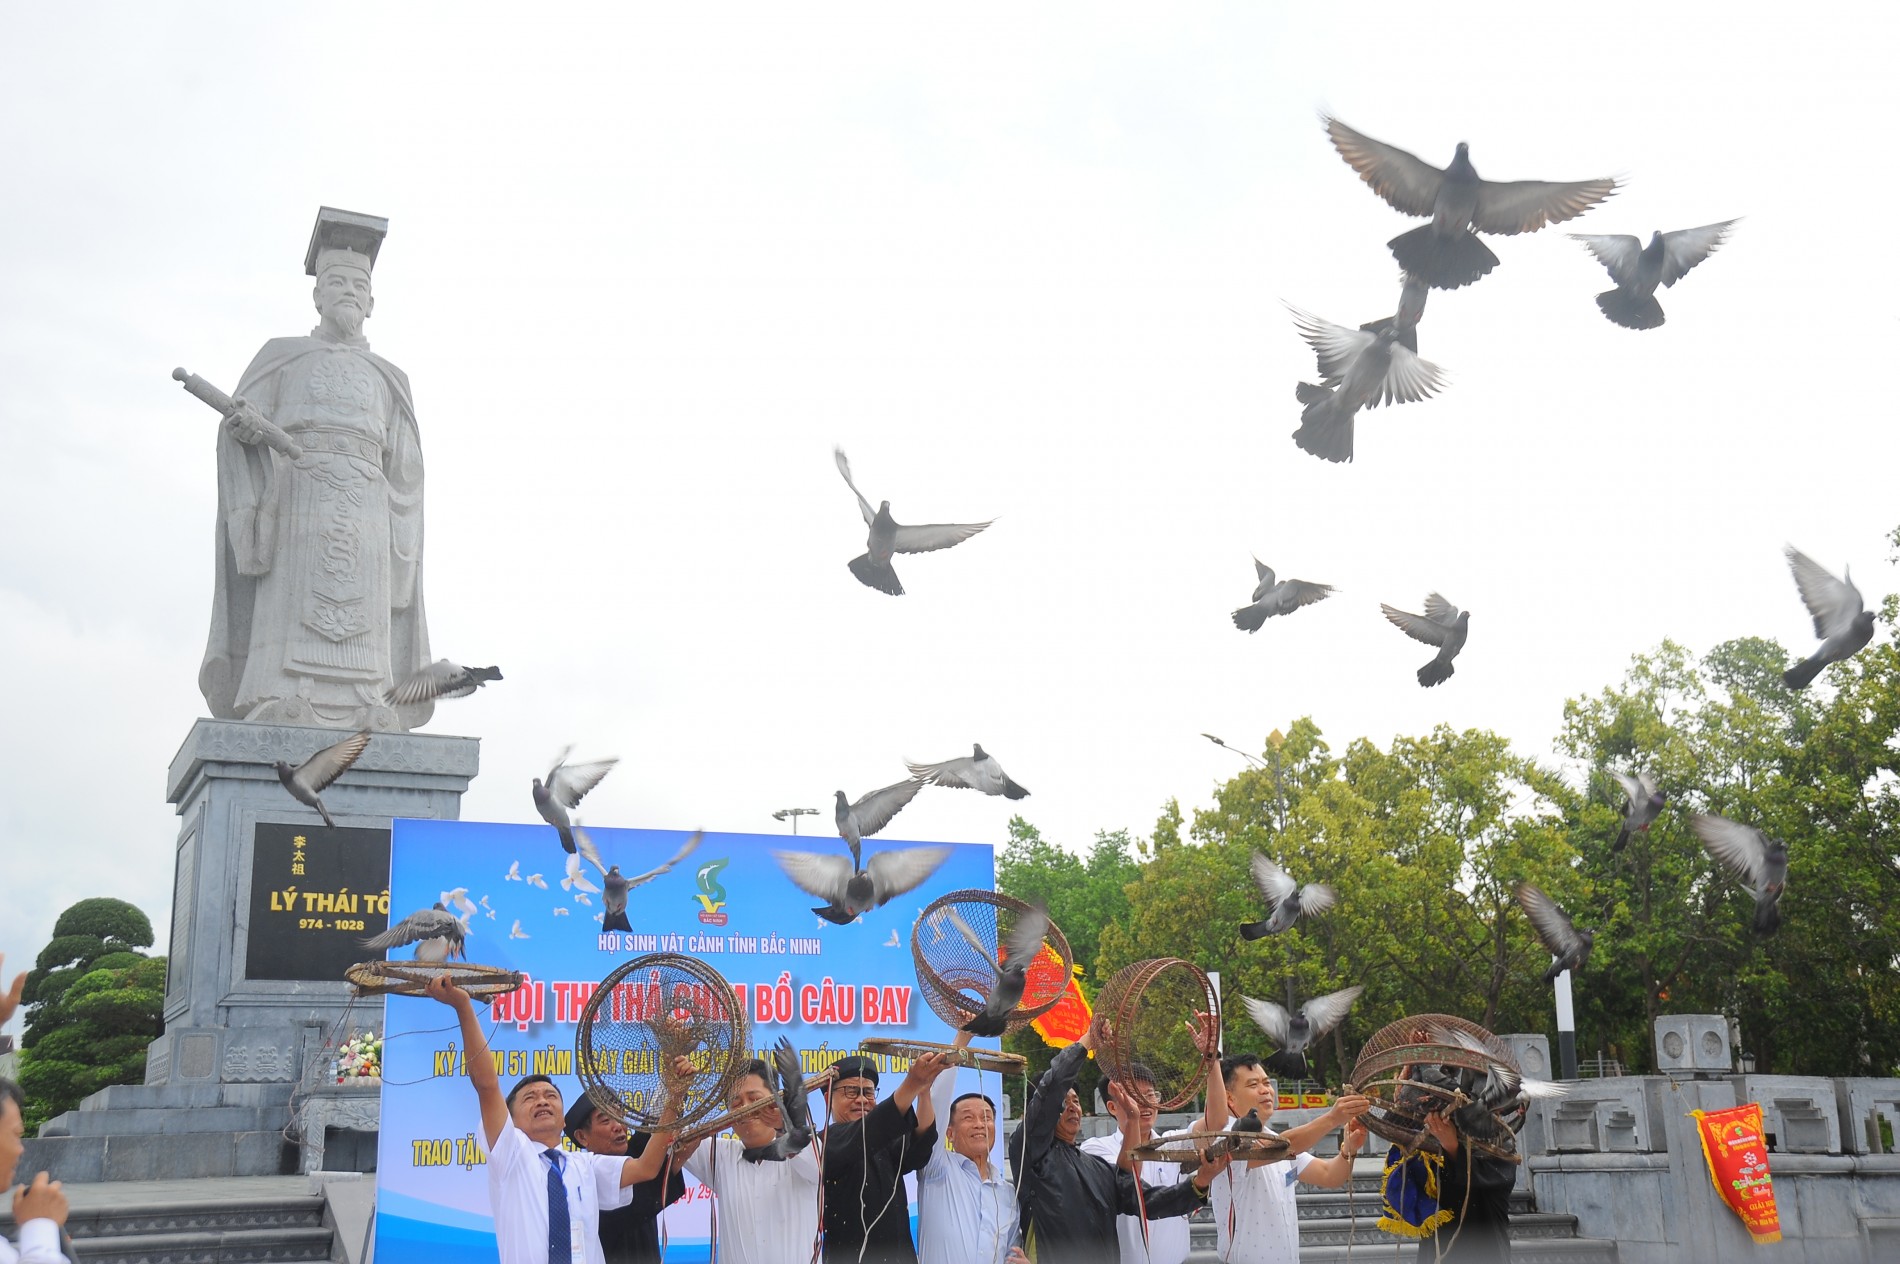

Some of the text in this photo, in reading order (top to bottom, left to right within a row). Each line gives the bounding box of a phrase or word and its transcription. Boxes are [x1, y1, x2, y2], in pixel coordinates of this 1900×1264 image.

[292, 835, 307, 875] 李太祖
[271, 886, 298, 911] LÝ
[302, 888, 358, 913] THÁI
[299, 918, 324, 930] 974
[336, 919, 365, 931] 1028
[598, 930, 822, 956] HỘI SINH VẬT CẢNH TỈNH BẮC NINH
[755, 970, 794, 1025] BỒ
[800, 976, 855, 1025] CÂU
[862, 985, 912, 1025] BAY
[434, 1042, 457, 1077] KỶ
[508, 1050, 528, 1076] 51
[533, 1044, 572, 1076] NĂM
[623, 1041, 654, 1075] GIẢI
[412, 1132, 487, 1171] TRAO TẶN
